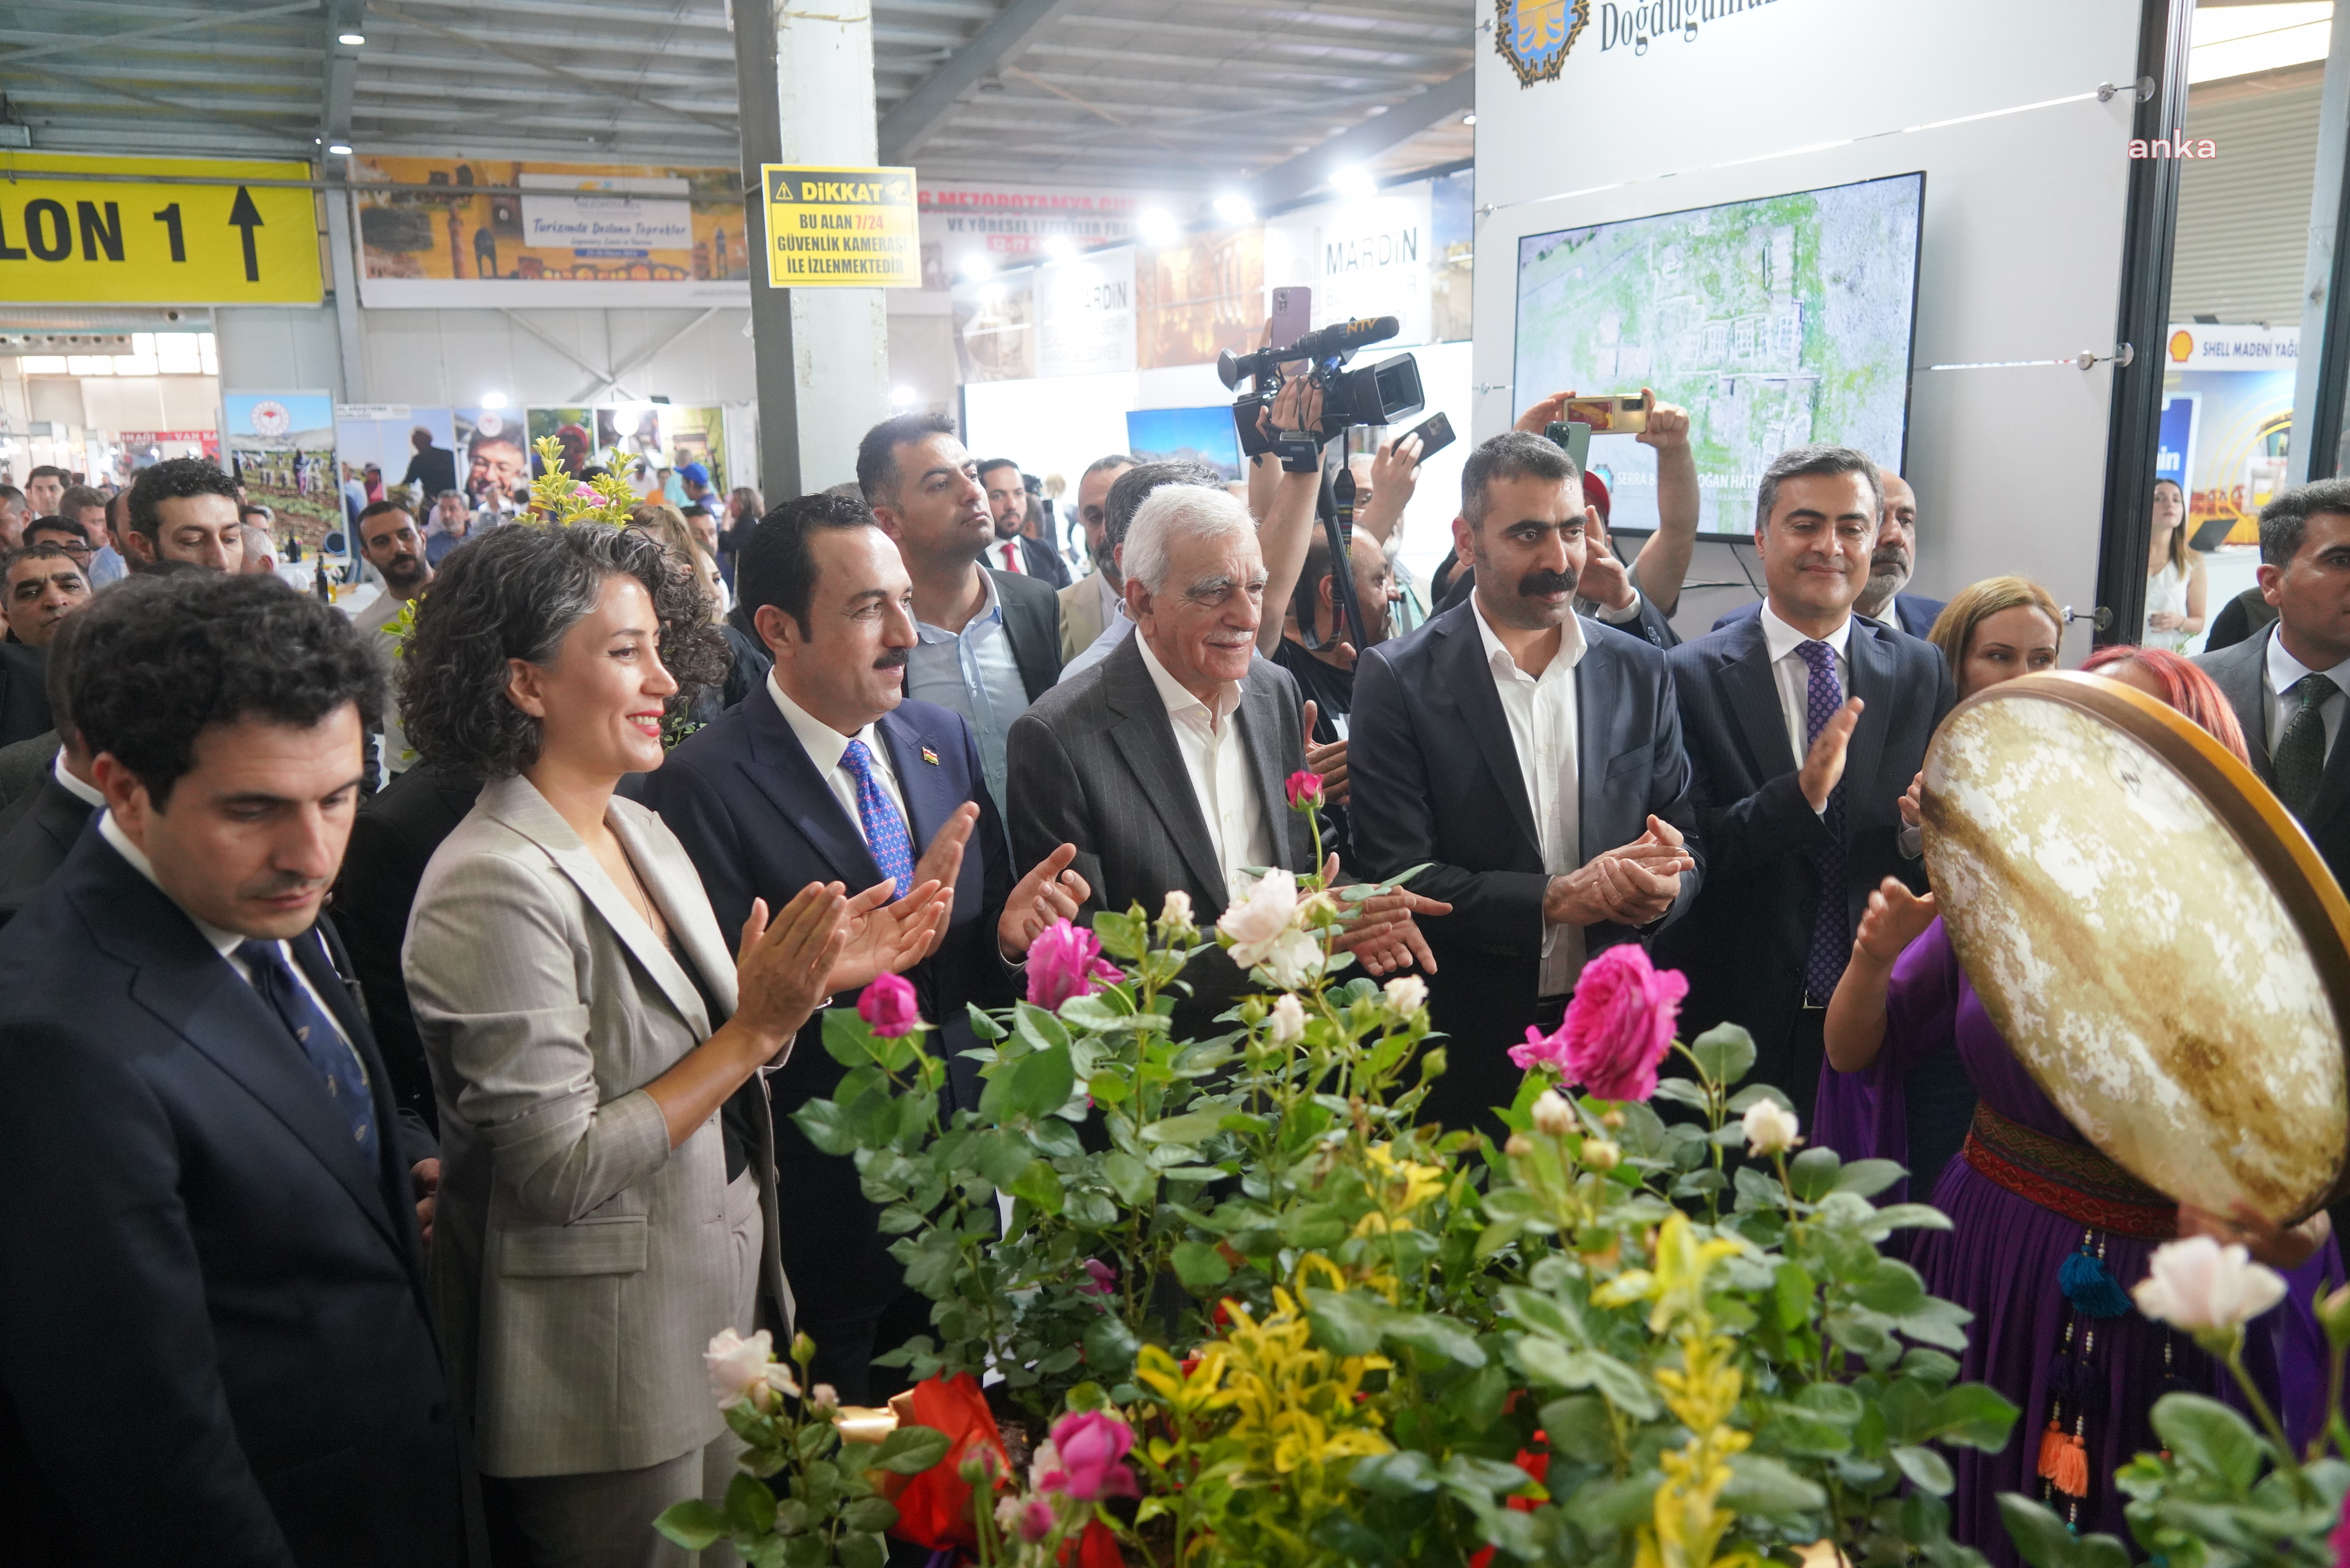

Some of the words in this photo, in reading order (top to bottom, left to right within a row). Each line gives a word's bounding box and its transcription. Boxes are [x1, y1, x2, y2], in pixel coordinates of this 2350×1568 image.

[799, 214, 818, 229] BU
[821, 214, 852, 229] ALAN
[855, 215, 884, 230] 7/24
[947, 218, 963, 233] VE
[154, 203, 186, 262] 1
[777, 234, 840, 251] GÜVENLİK
[843, 236, 908, 252] KAMERASI
[787, 256, 805, 273] İLE
[808, 256, 904, 274] İZLENMEKTEDİR
[1346, 317, 1379, 335] NTV
[2203, 341, 2230, 357] SHELL
[2233, 338, 2273, 357] MADENİ
[1617, 472, 1647, 486] SERRA
[1697, 472, 1728, 488] OĞAN
[1730, 474, 1761, 489] HATU
